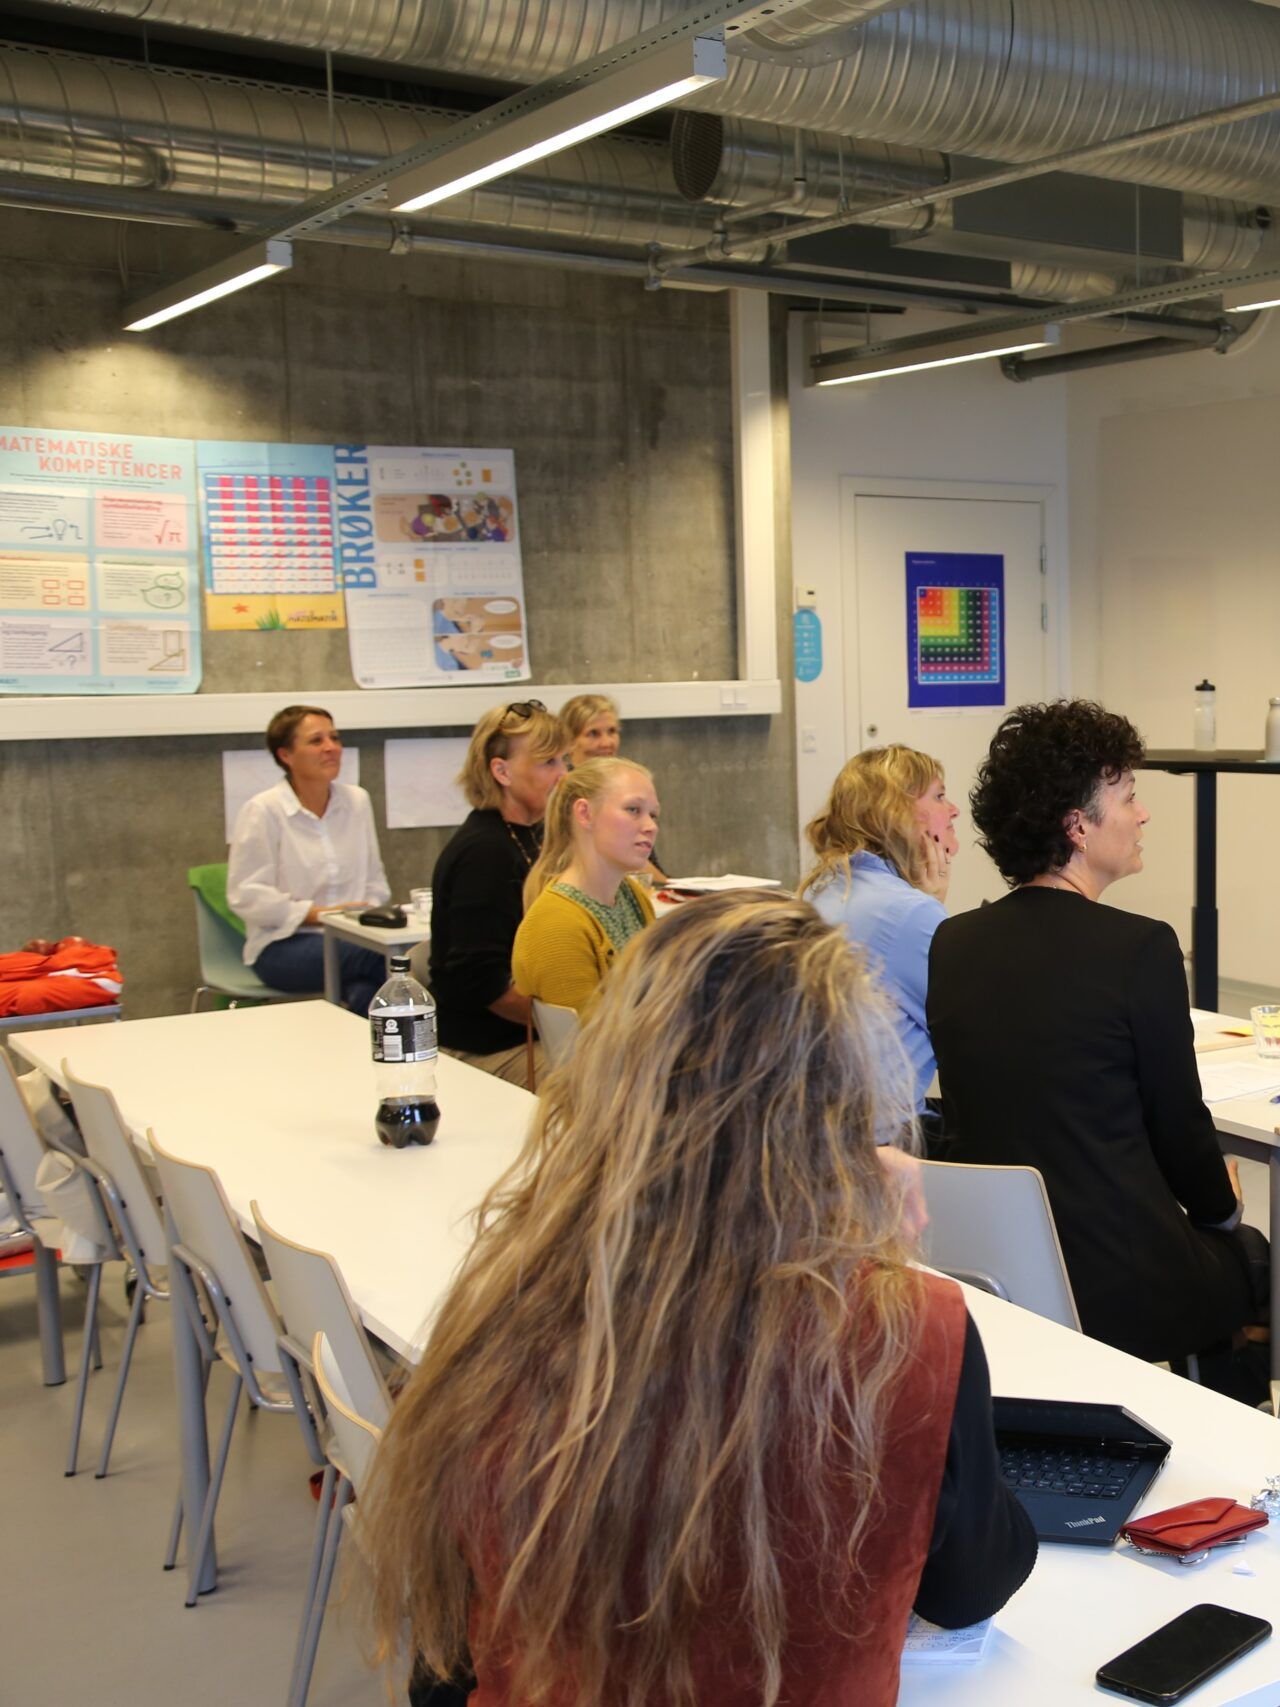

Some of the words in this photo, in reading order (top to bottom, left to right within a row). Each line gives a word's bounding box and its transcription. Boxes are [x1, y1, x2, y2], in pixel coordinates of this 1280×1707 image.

[38, 456, 182, 480] KOMPETENCER
[335, 443, 376, 588] BRØKER
[1065, 1515, 1106, 1529] ThinkPad
